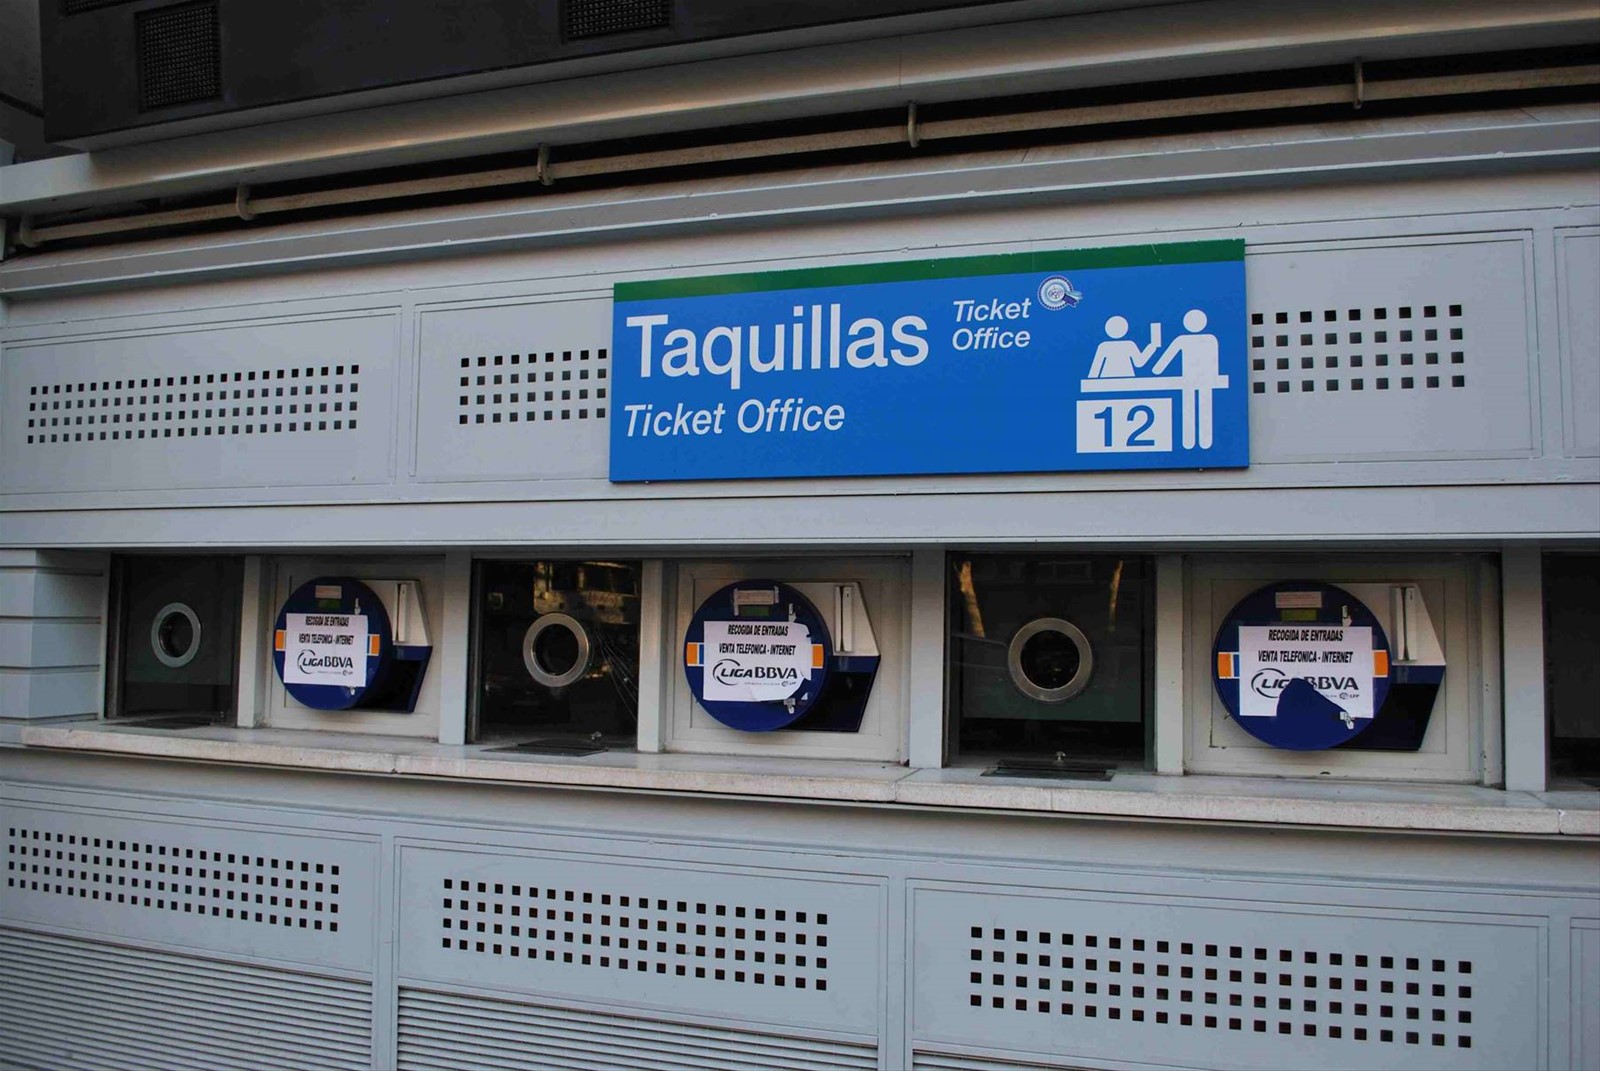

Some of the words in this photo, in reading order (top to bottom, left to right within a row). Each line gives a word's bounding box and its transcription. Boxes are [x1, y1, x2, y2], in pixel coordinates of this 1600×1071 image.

[952, 297, 1031, 324] Ticket
[625, 304, 930, 390] Taquillas
[951, 326, 1031, 352] Office
[623, 402, 726, 437] Ticket
[736, 398, 846, 433] Office
[1093, 405, 1156, 448] 12
[728, 624, 753, 635] RECOGIDA
[753, 625, 760, 635] DE
[761, 625, 789, 636] ENTRADAS
[1268, 629, 1299, 641] RECOGIDA
[1300, 629, 1310, 641] DE
[1310, 629, 1344, 642] ENTRADAS
[719, 643, 735, 653] VENTA
[770, 645, 796, 656] INTERNET
[1258, 650, 1278, 662] VENTA
[1279, 650, 1317, 663] TELEFONICA
[1321, 651, 1354, 663] INTERNET
